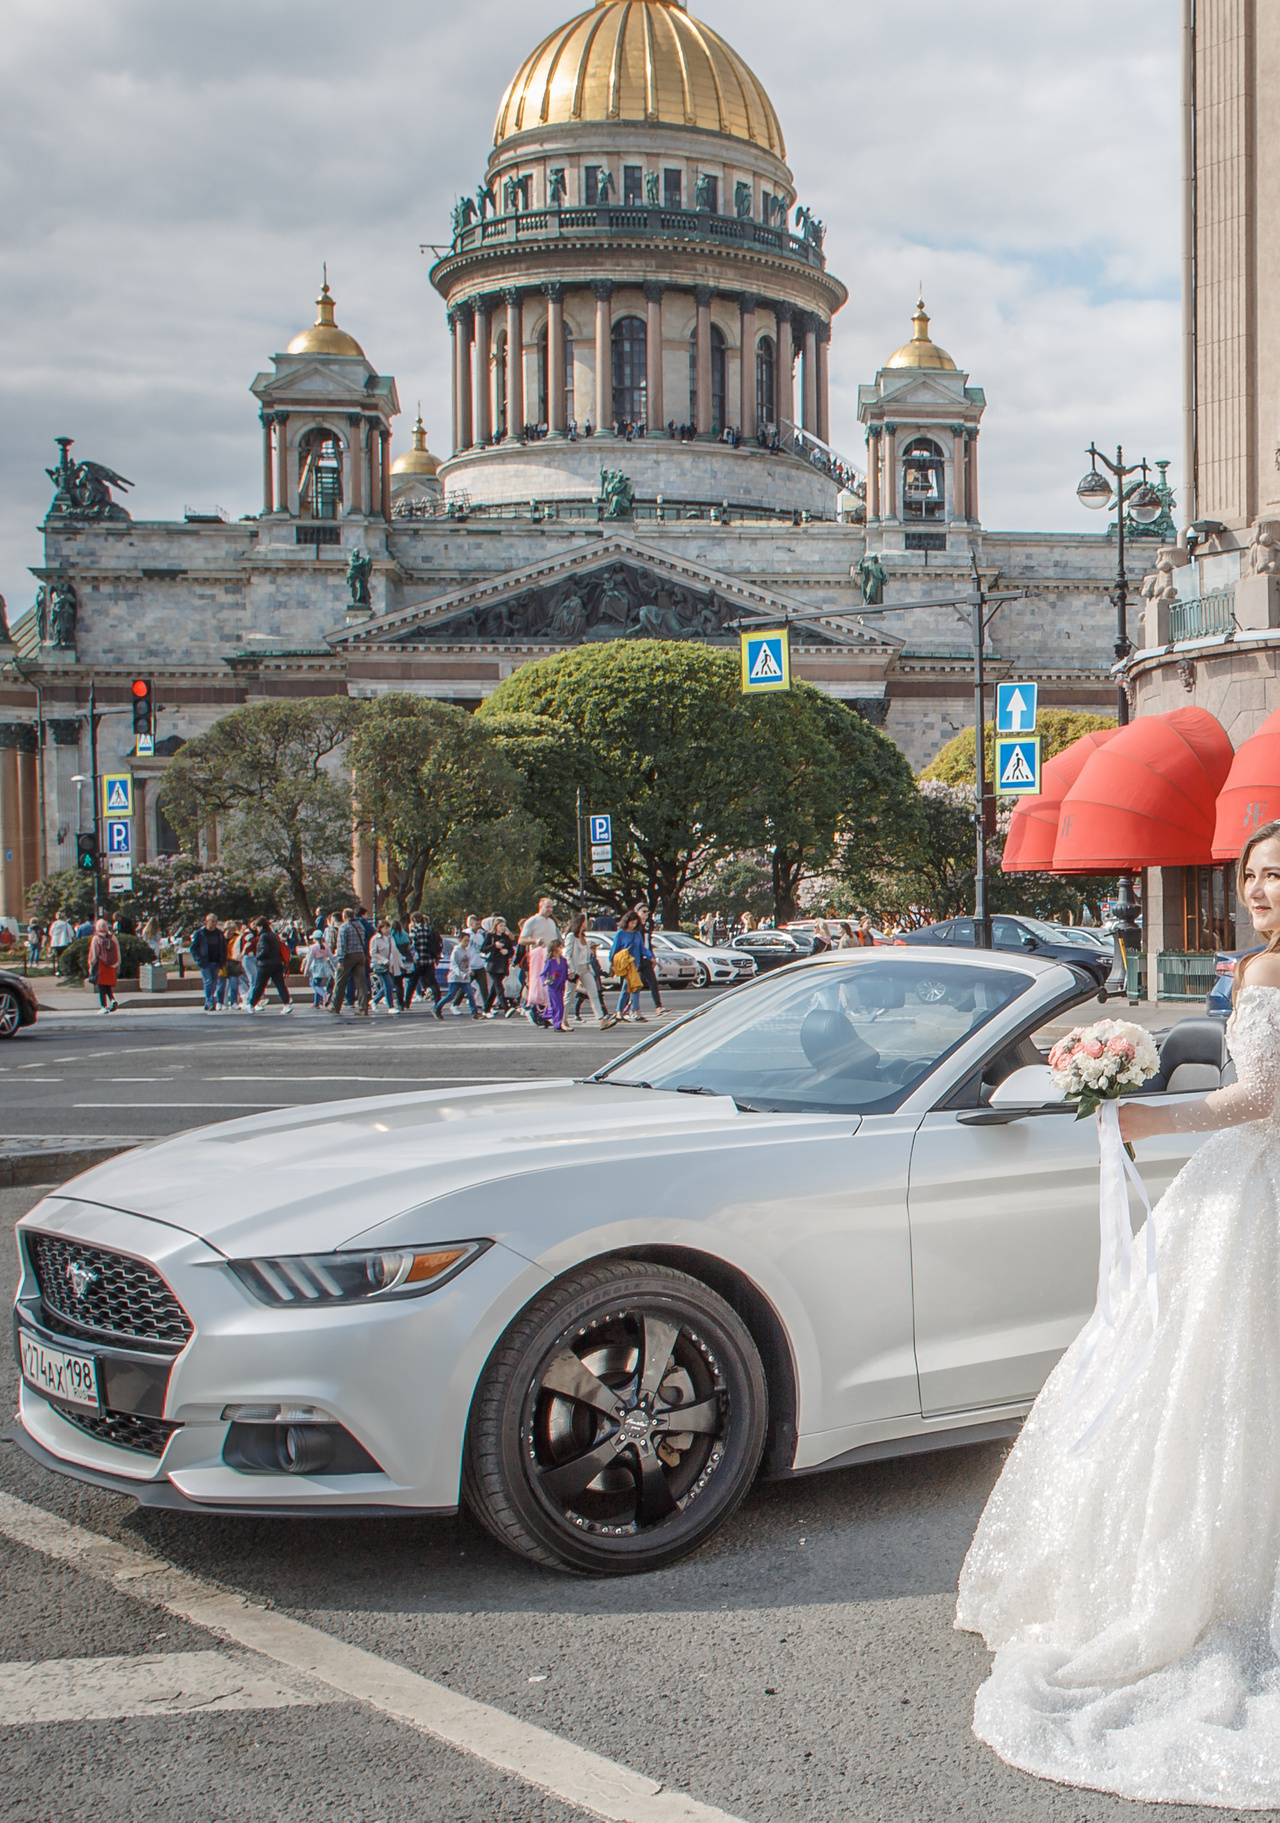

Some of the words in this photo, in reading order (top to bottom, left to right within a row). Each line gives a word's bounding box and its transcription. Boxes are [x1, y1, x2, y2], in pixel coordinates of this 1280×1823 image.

[113, 823, 126, 850] P
[66, 1358, 92, 1390] 198
[74, 1387, 88, 1400] RUS
